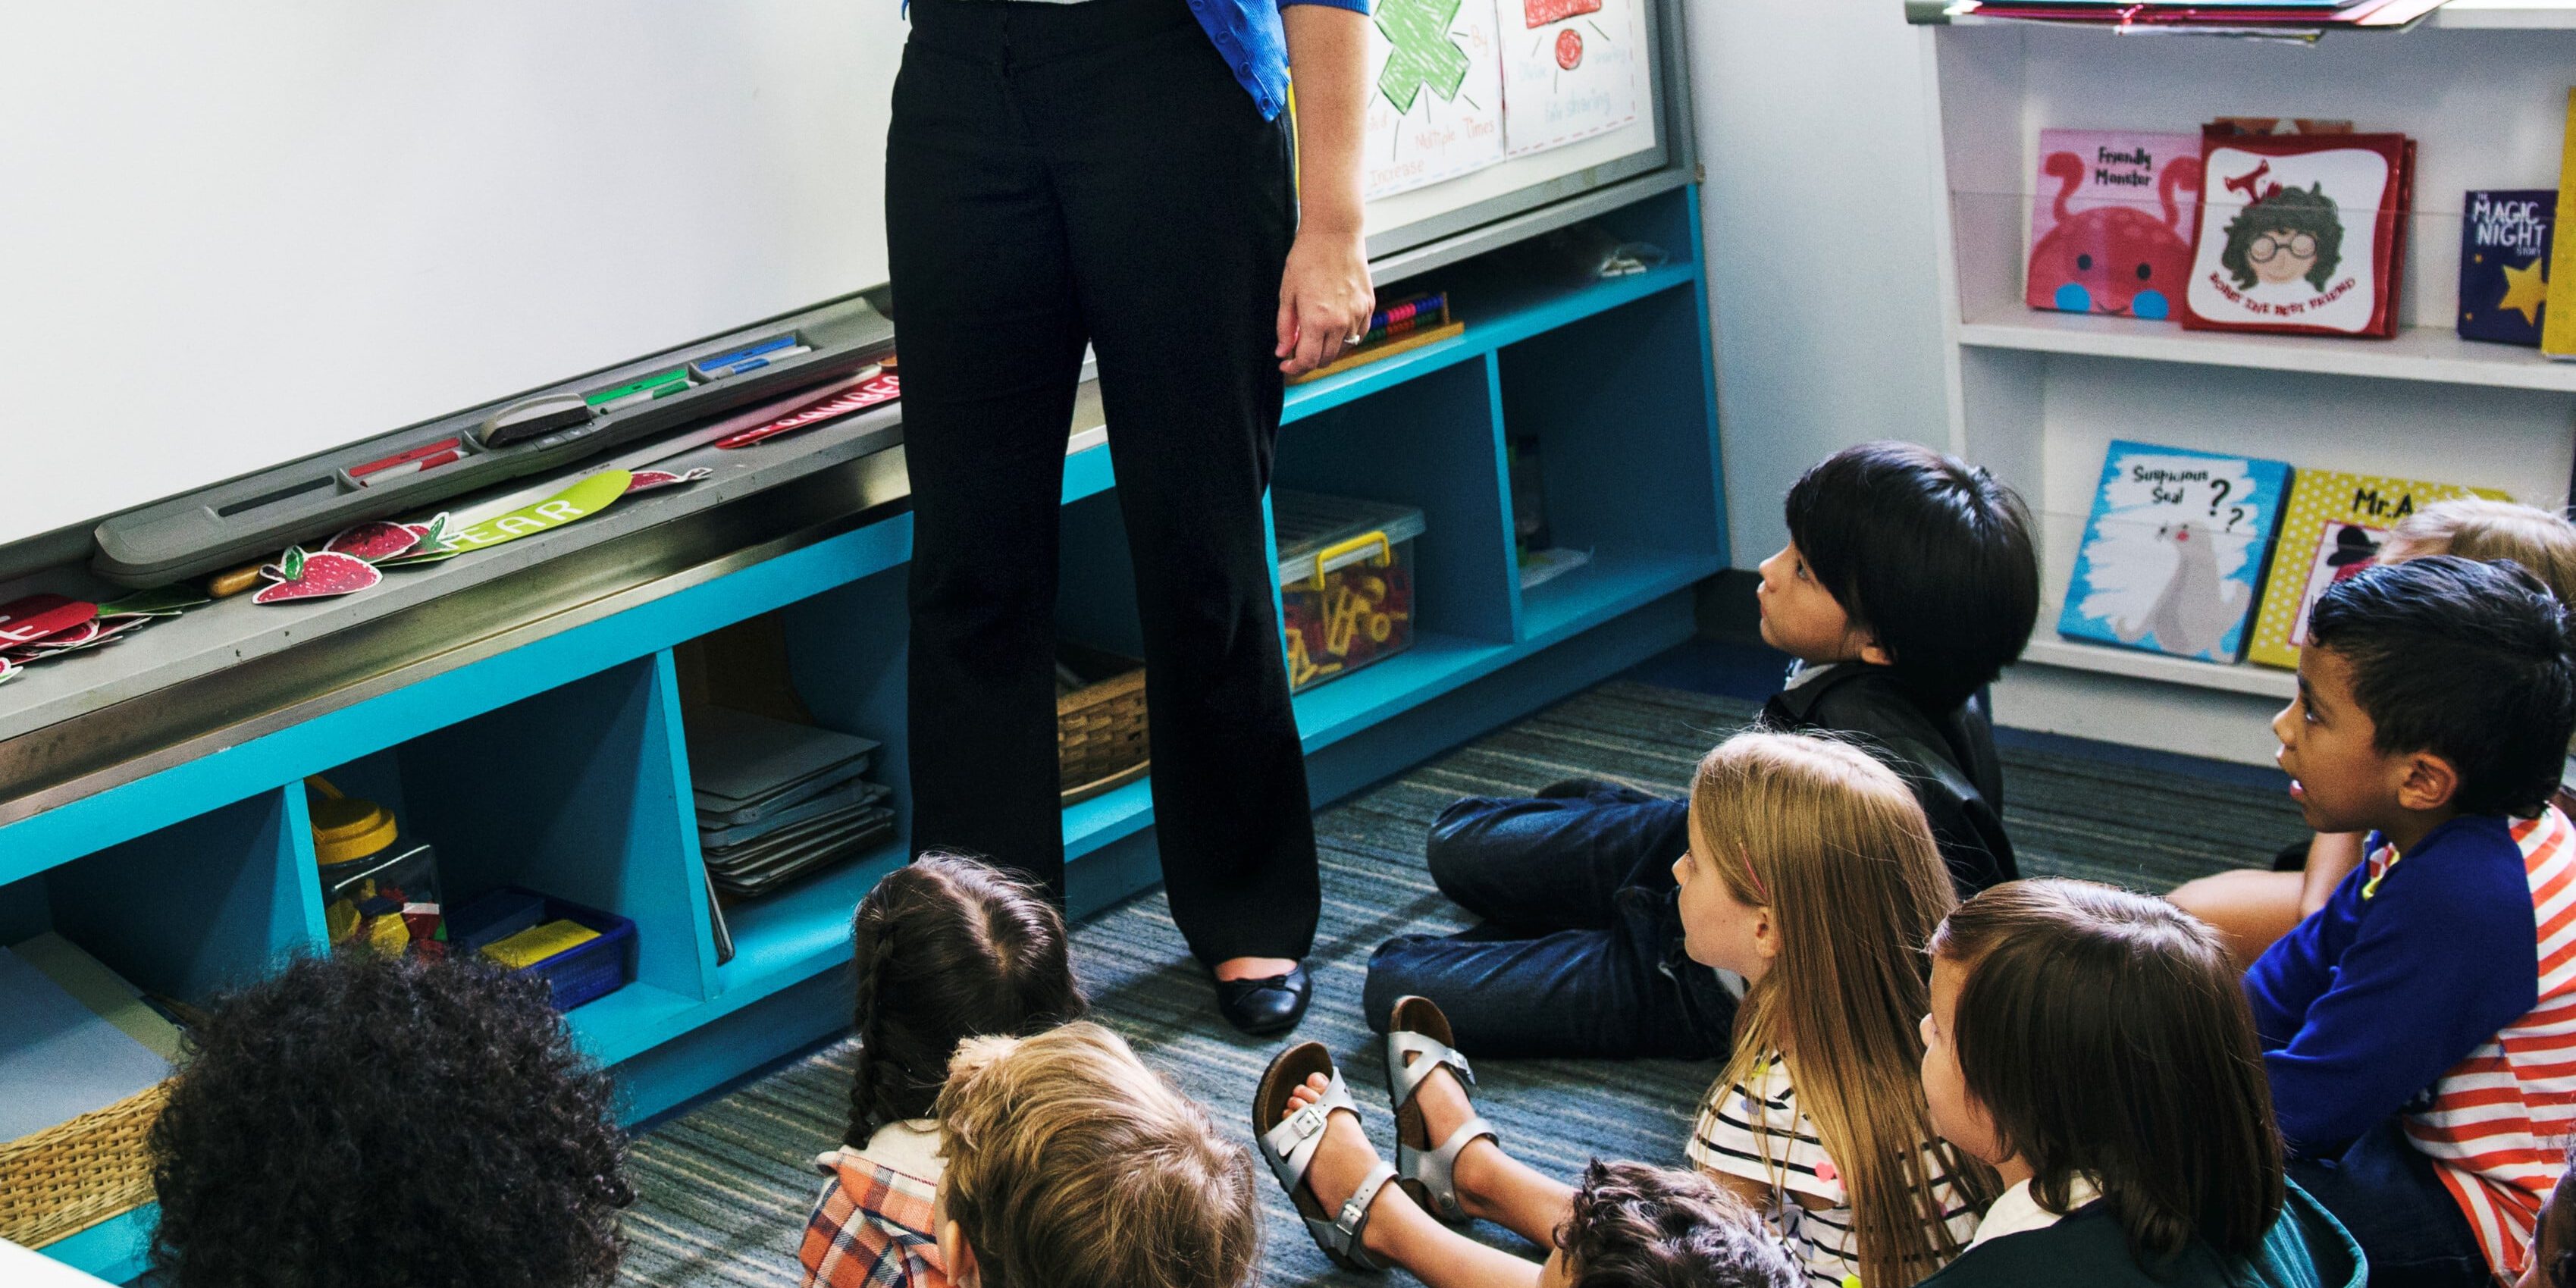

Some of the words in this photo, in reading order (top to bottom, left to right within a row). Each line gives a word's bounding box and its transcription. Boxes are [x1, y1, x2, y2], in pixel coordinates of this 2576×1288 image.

[1462, 116, 1495, 139] Times
[2098, 146, 2151, 172] Friendly
[1370, 159, 1425, 188] Increase
[2095, 169, 2152, 186] Monster
[2473, 200, 2540, 226] MAGIC
[2476, 221, 2546, 247] NIGHT
[2244, 297, 2270, 315] THE
[2274, 303, 2306, 317] BEST
[2308, 277, 2356, 309] FRIEND
[2133, 463, 2209, 485] Suspicious
[2152, 485, 2185, 505] Seal
[2209, 478, 2231, 517] ?
[453, 500, 584, 544] EAR
[2226, 506, 2245, 533] ?
